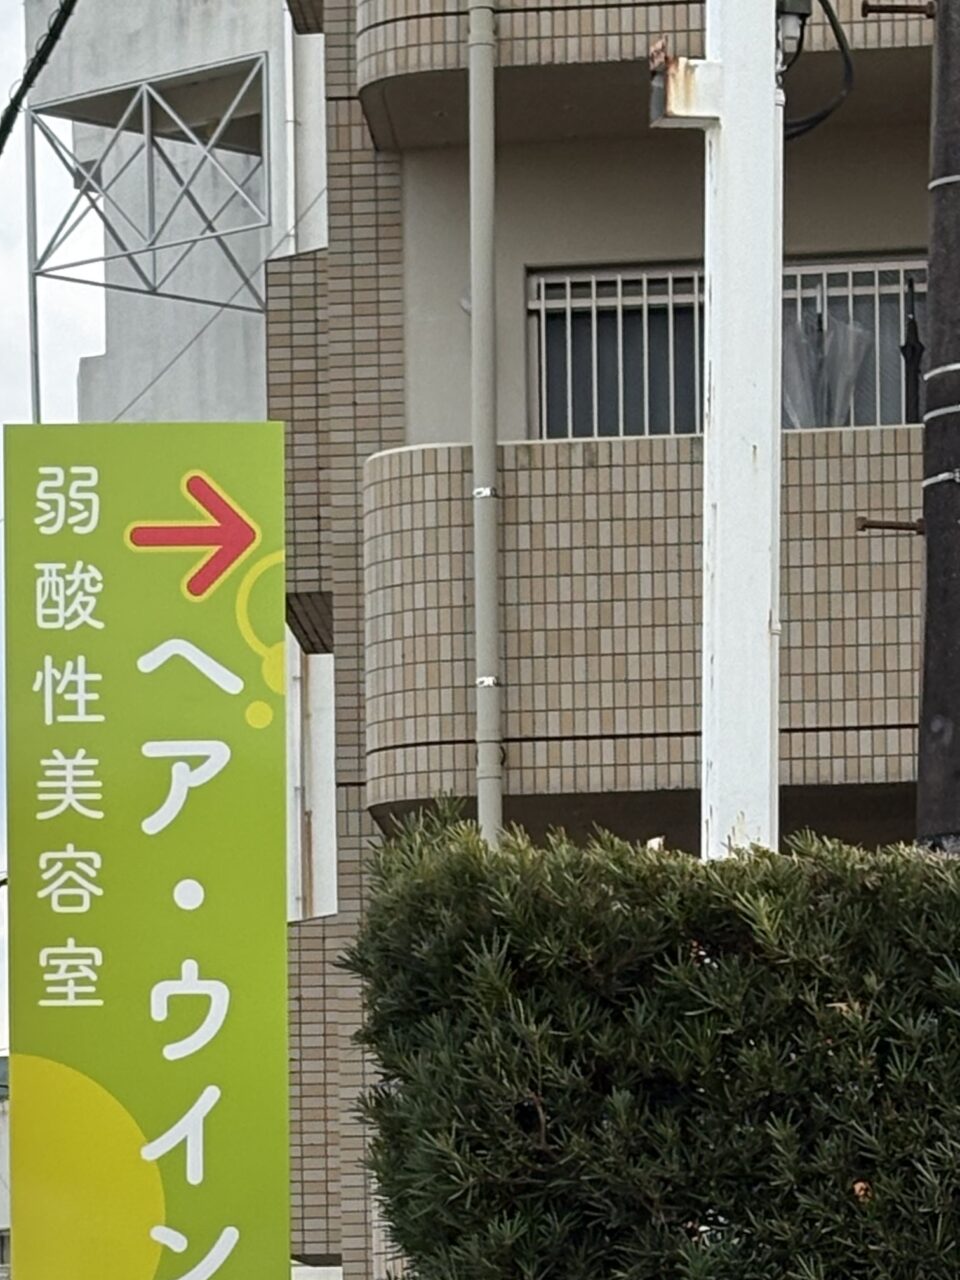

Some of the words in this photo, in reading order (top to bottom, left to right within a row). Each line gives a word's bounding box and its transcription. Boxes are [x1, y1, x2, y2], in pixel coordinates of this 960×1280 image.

[32, 465, 105, 1008] 弱酸性美容室
